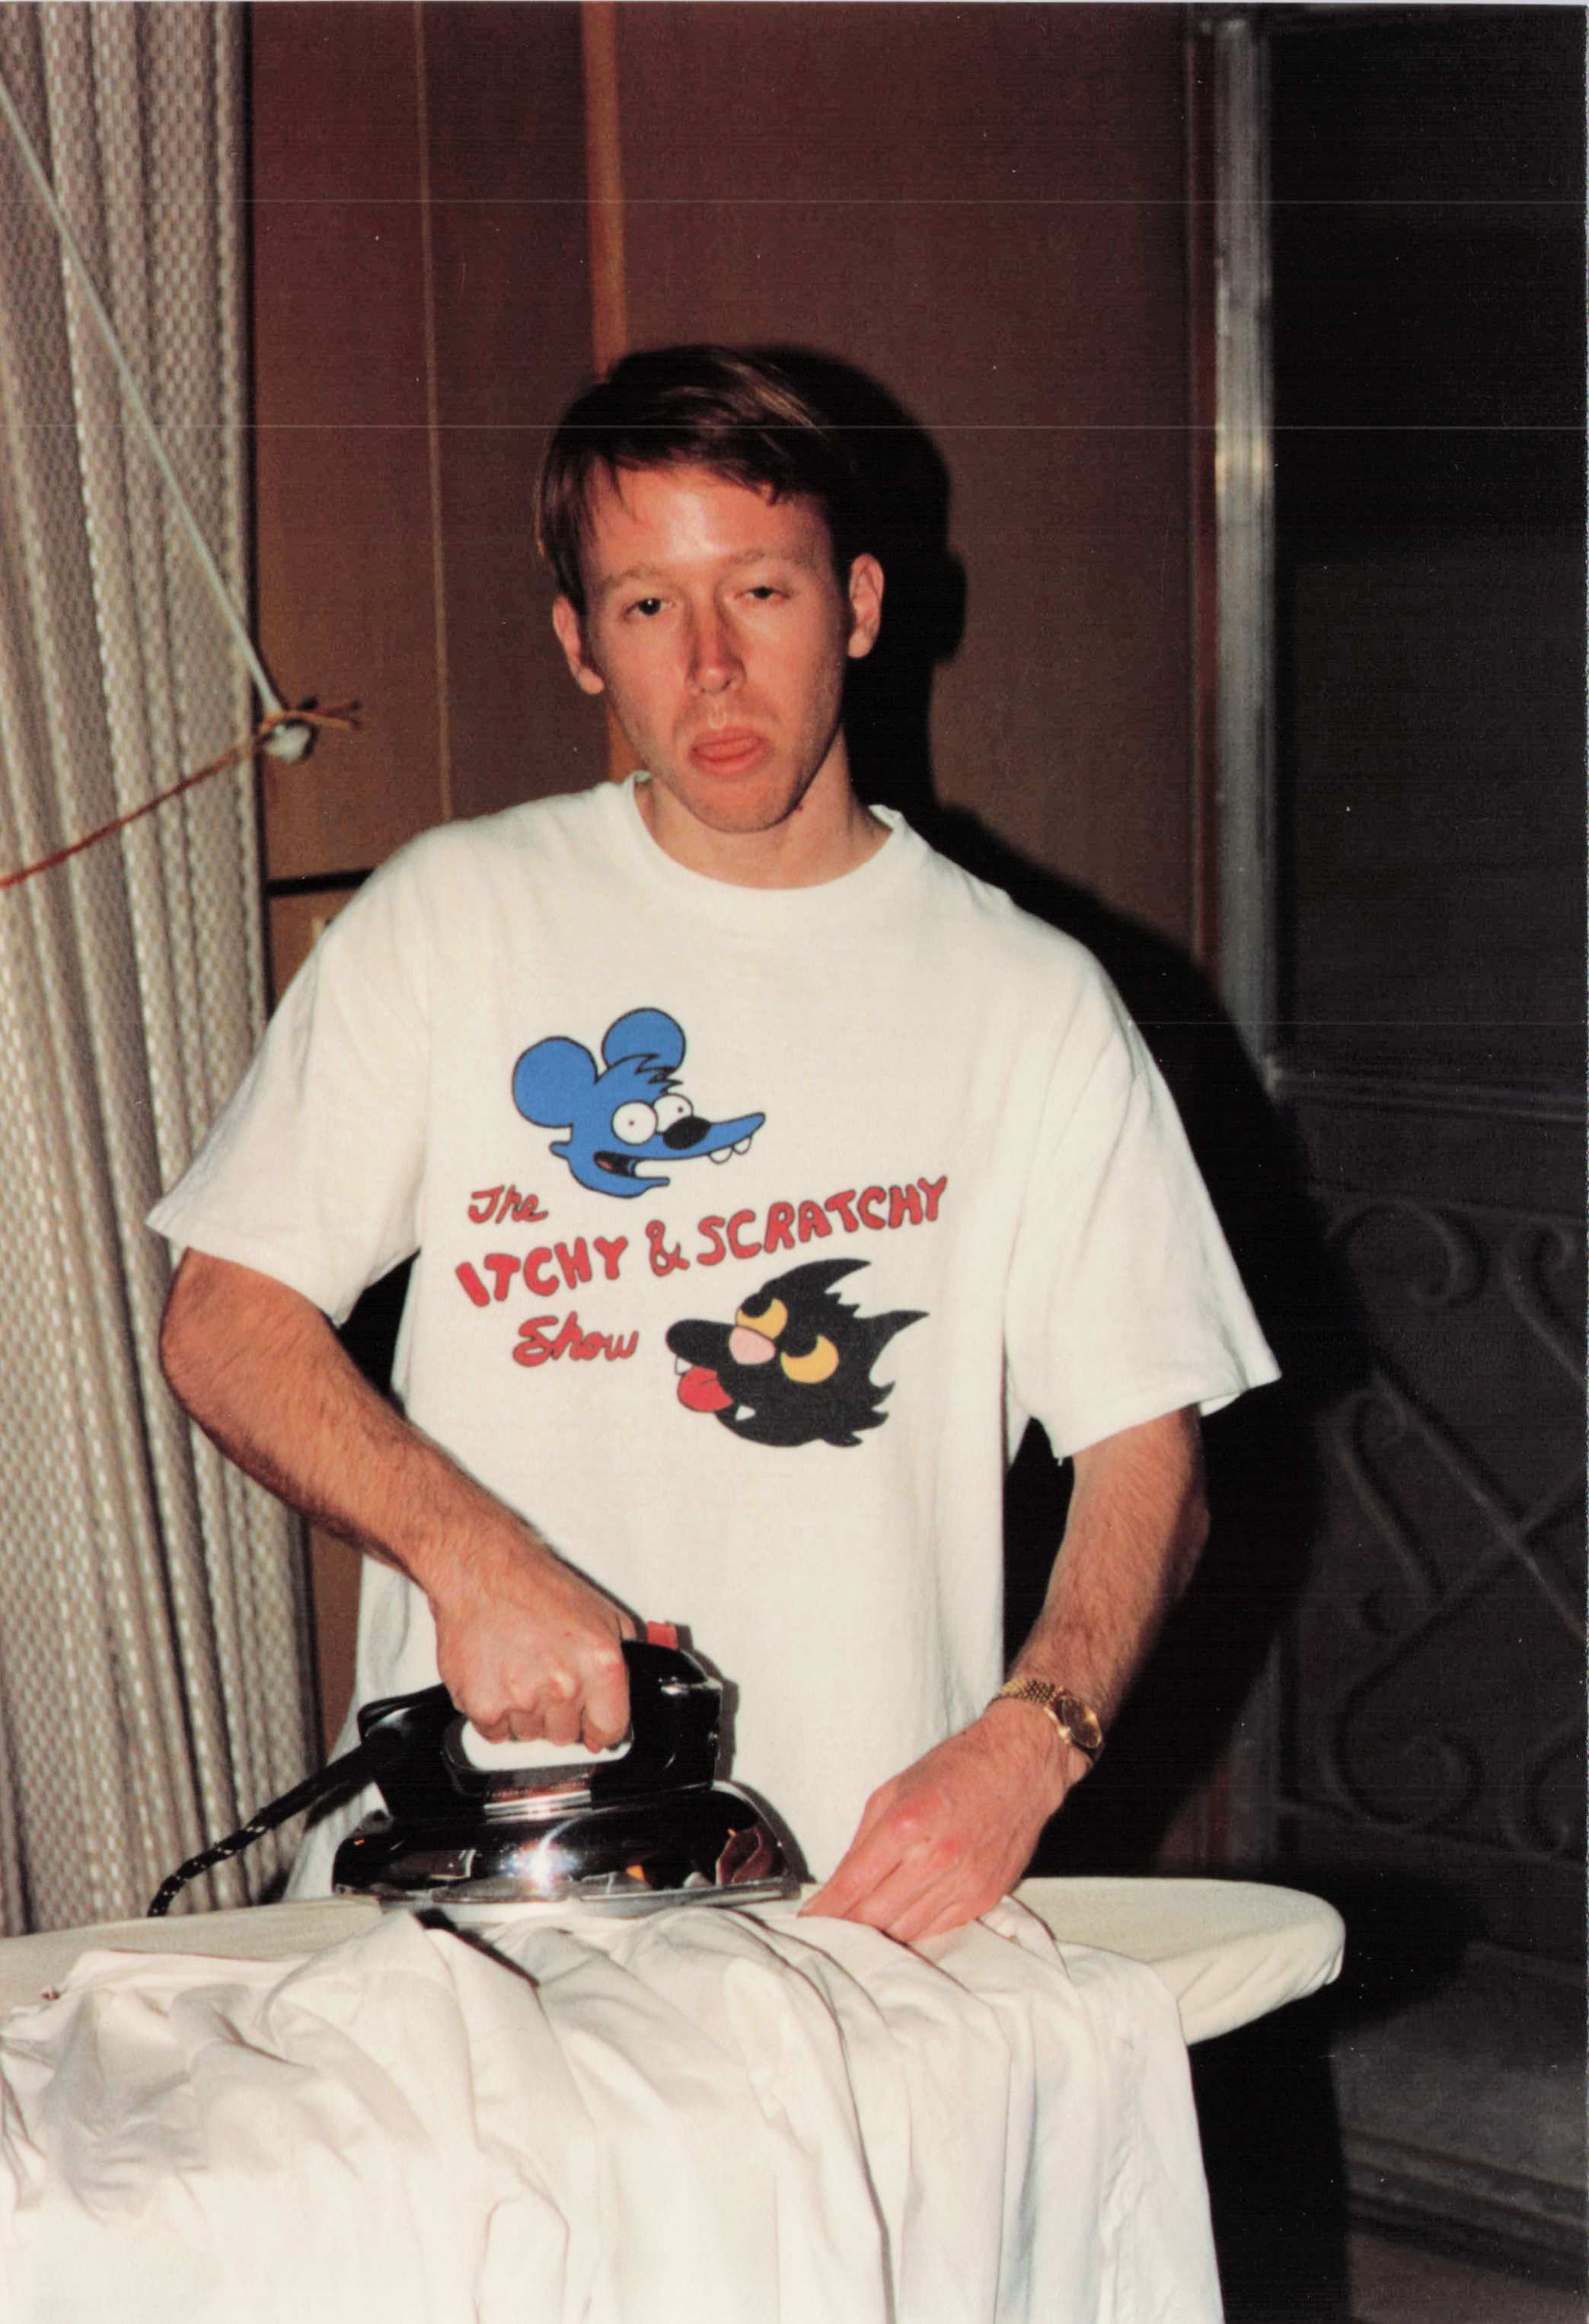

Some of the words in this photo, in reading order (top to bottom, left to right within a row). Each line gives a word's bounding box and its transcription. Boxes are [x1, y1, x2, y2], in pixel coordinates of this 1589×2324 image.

[467, 1184, 549, 1224] The
[455, 1235, 628, 1308] ITCHY
[645, 1219, 690, 1277] &
[697, 1175, 948, 1266] SCRATCHY
[512, 1311, 640, 1368] Show
